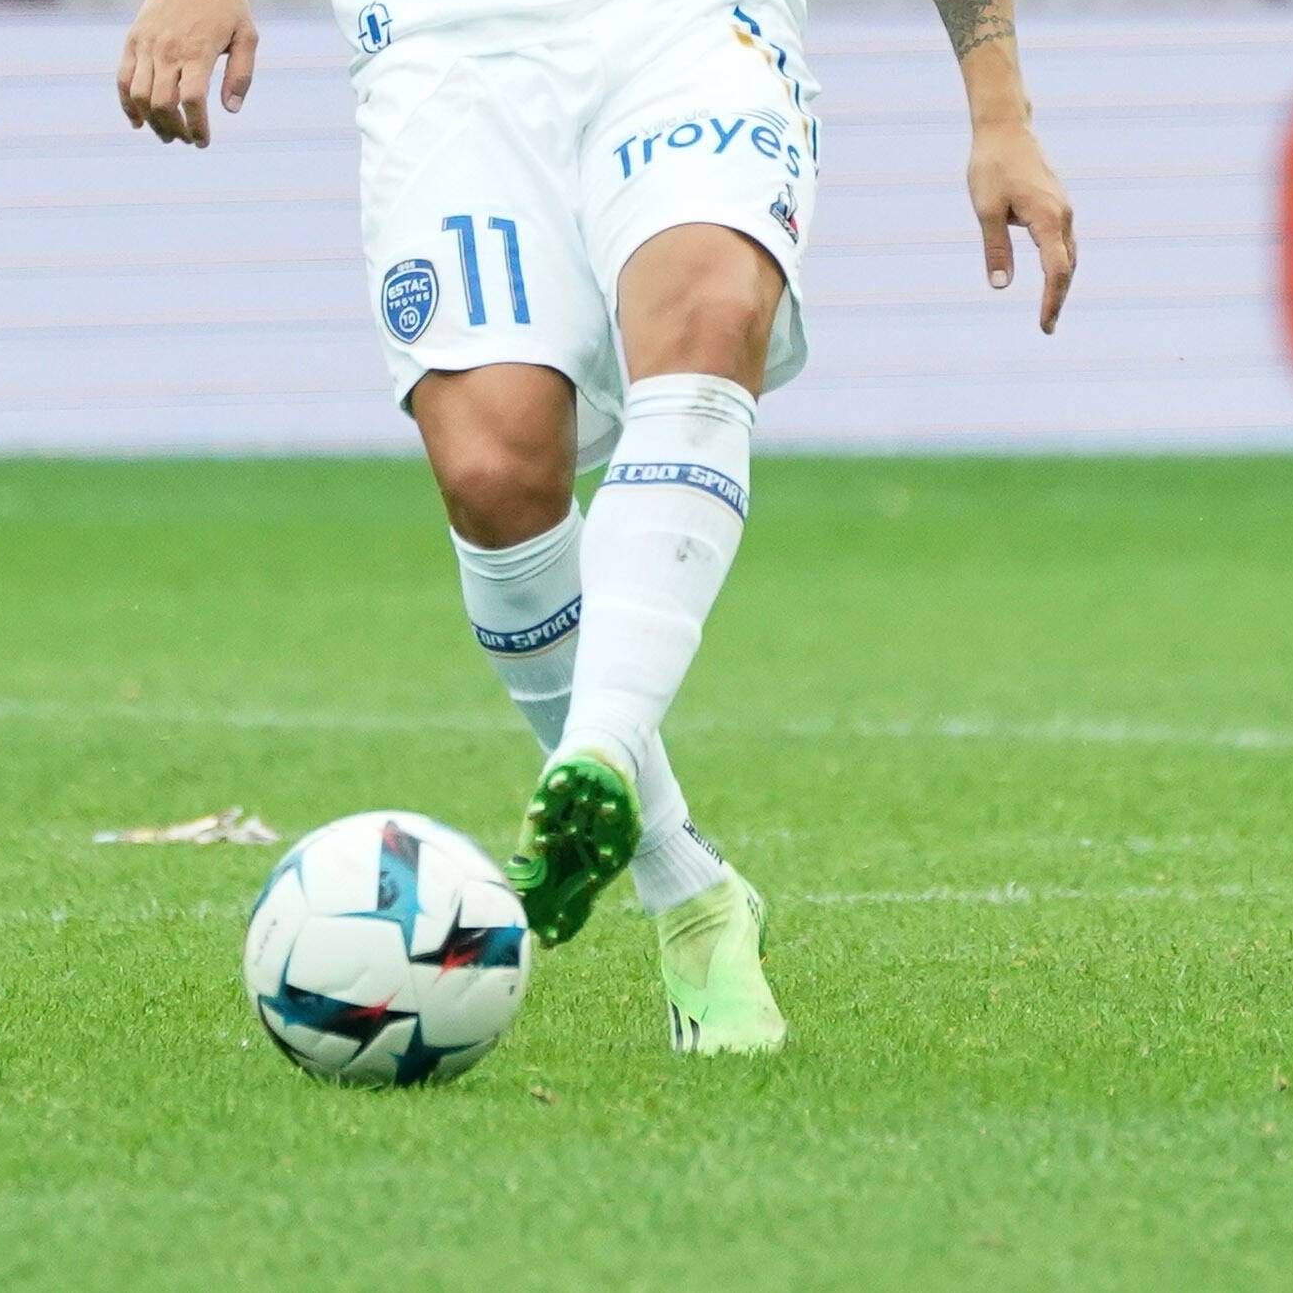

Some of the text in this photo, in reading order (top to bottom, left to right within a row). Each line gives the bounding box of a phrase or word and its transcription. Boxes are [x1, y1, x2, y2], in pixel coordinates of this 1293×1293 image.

[613, 118, 801, 180] Troyes
[388, 277, 429, 300] ESTAC
[441, 215, 531, 326] 11
[402, 312, 416, 327] 10
